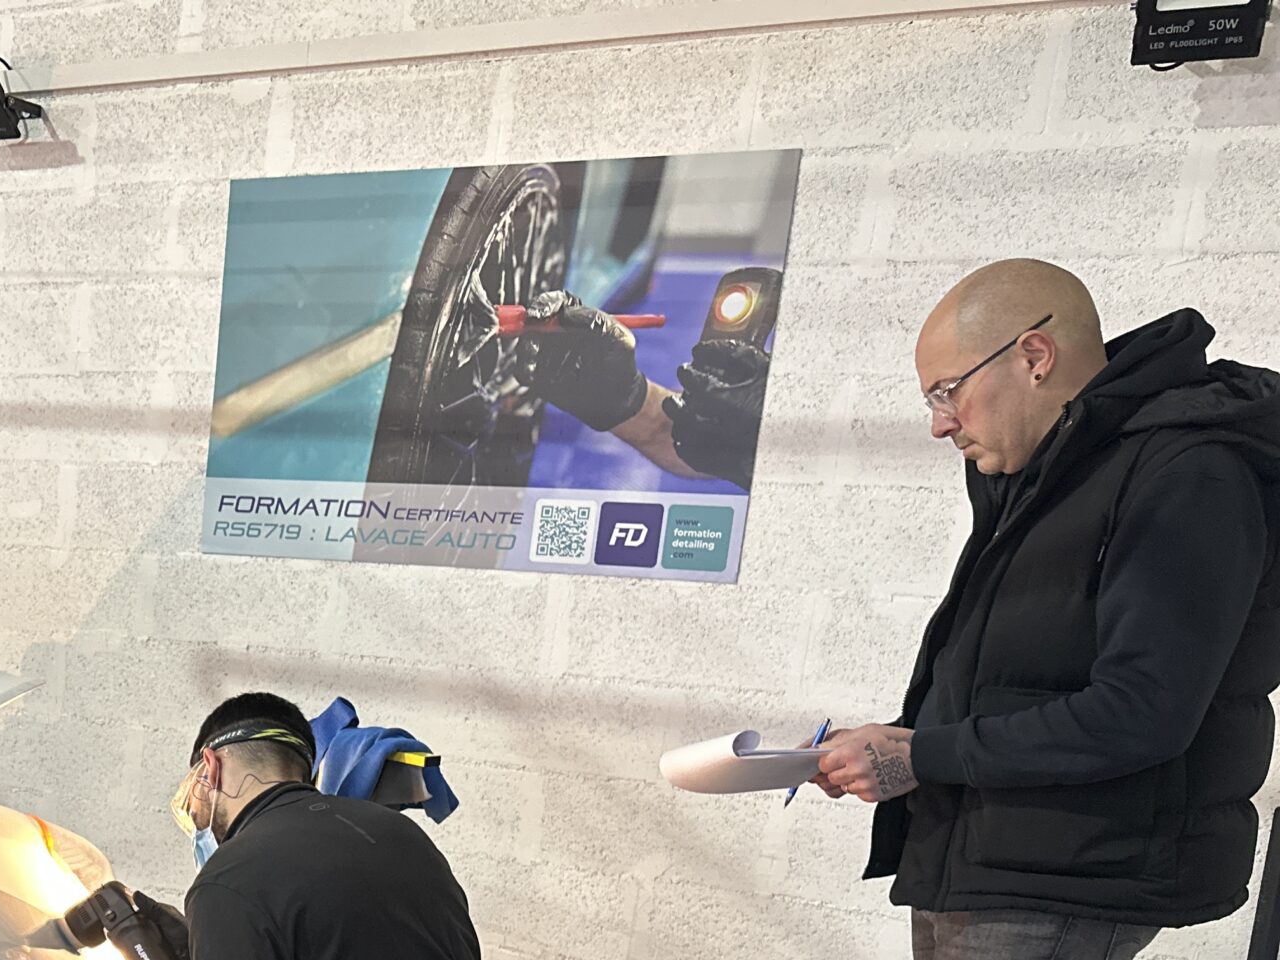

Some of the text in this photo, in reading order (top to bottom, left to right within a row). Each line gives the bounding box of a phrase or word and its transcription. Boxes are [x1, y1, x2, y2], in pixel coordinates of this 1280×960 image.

[1208, 18, 1239, 31] 50W
[1149, 41, 1165, 50] LED
[1169, 37, 1218, 48] FLOODLIGHT
[218, 495, 524, 525] FORMATION CERTIFIANTE
[213, 520, 302, 541] RS6719
[325, 525, 427, 547] LAVAGE
[435, 531, 517, 551] AUTO
[608, 522, 649, 547] FD
[673, 527, 722, 539] formation
[672, 539, 715, 551] detailing
